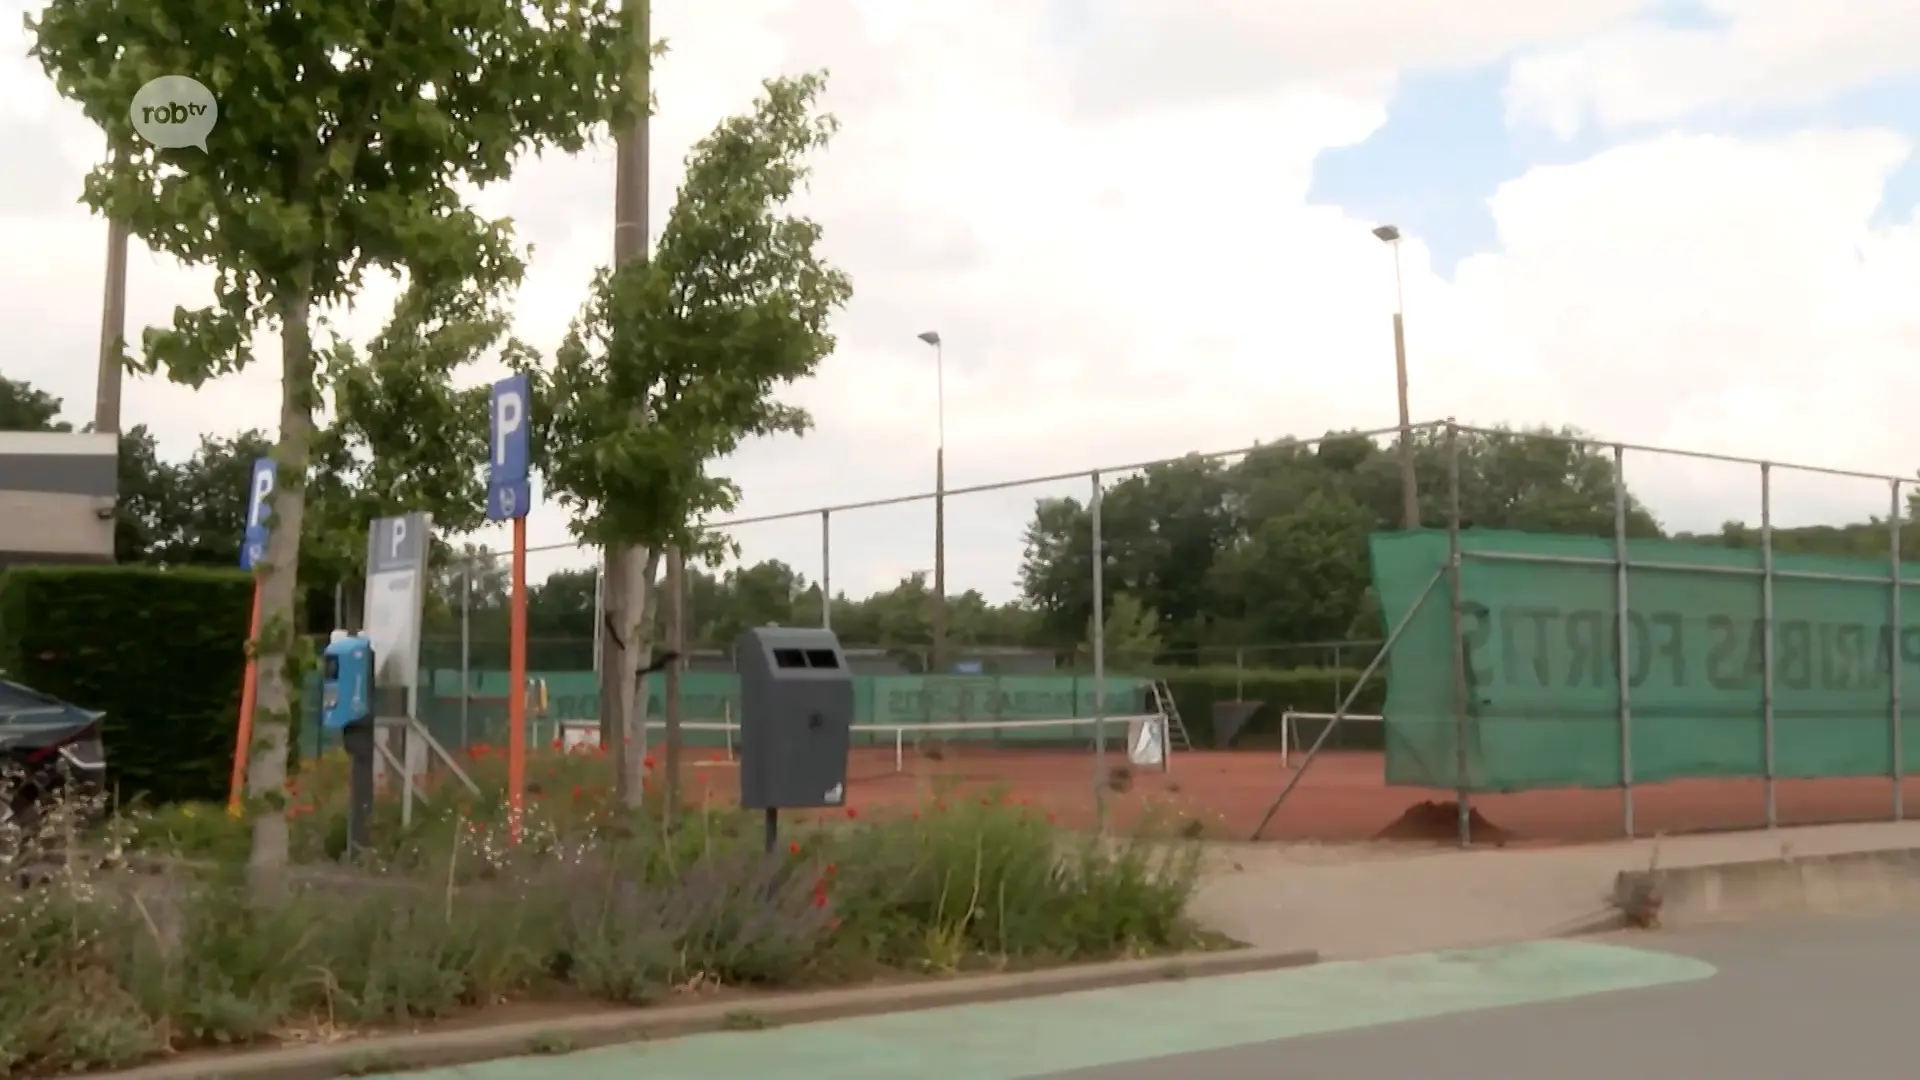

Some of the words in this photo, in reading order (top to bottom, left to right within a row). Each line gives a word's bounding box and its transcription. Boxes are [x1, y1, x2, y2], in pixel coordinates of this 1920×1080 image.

[496, 392, 523, 466] P
[250, 469, 274, 527] P
[391, 517, 407, 558] P
